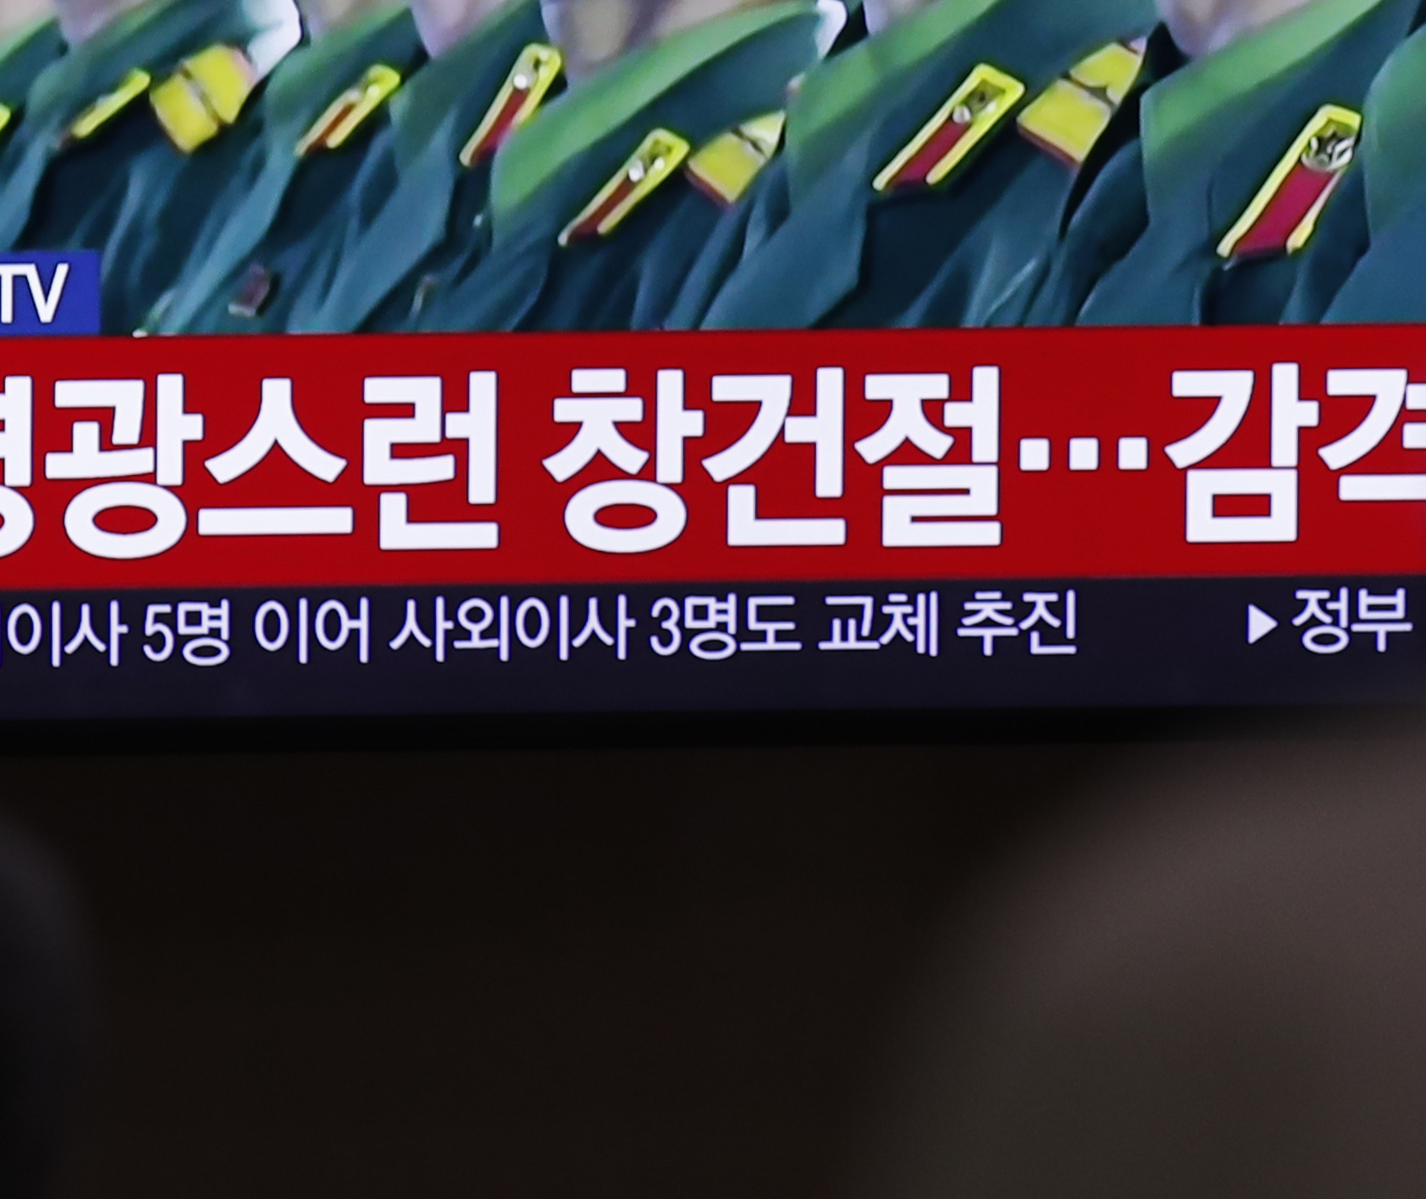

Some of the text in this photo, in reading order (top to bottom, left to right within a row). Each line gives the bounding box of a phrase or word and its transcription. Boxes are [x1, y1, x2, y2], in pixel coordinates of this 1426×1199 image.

[143, 598, 230, 667] 5명
[254, 597, 369, 664] 이어
[389, 594, 637, 663] 사외이사
[650, 591, 802, 660] 3명도
[818, 589, 939, 657] 교체
[956, 588, 1077, 657] 추진
[1291, 586, 1414, 654] 정부
